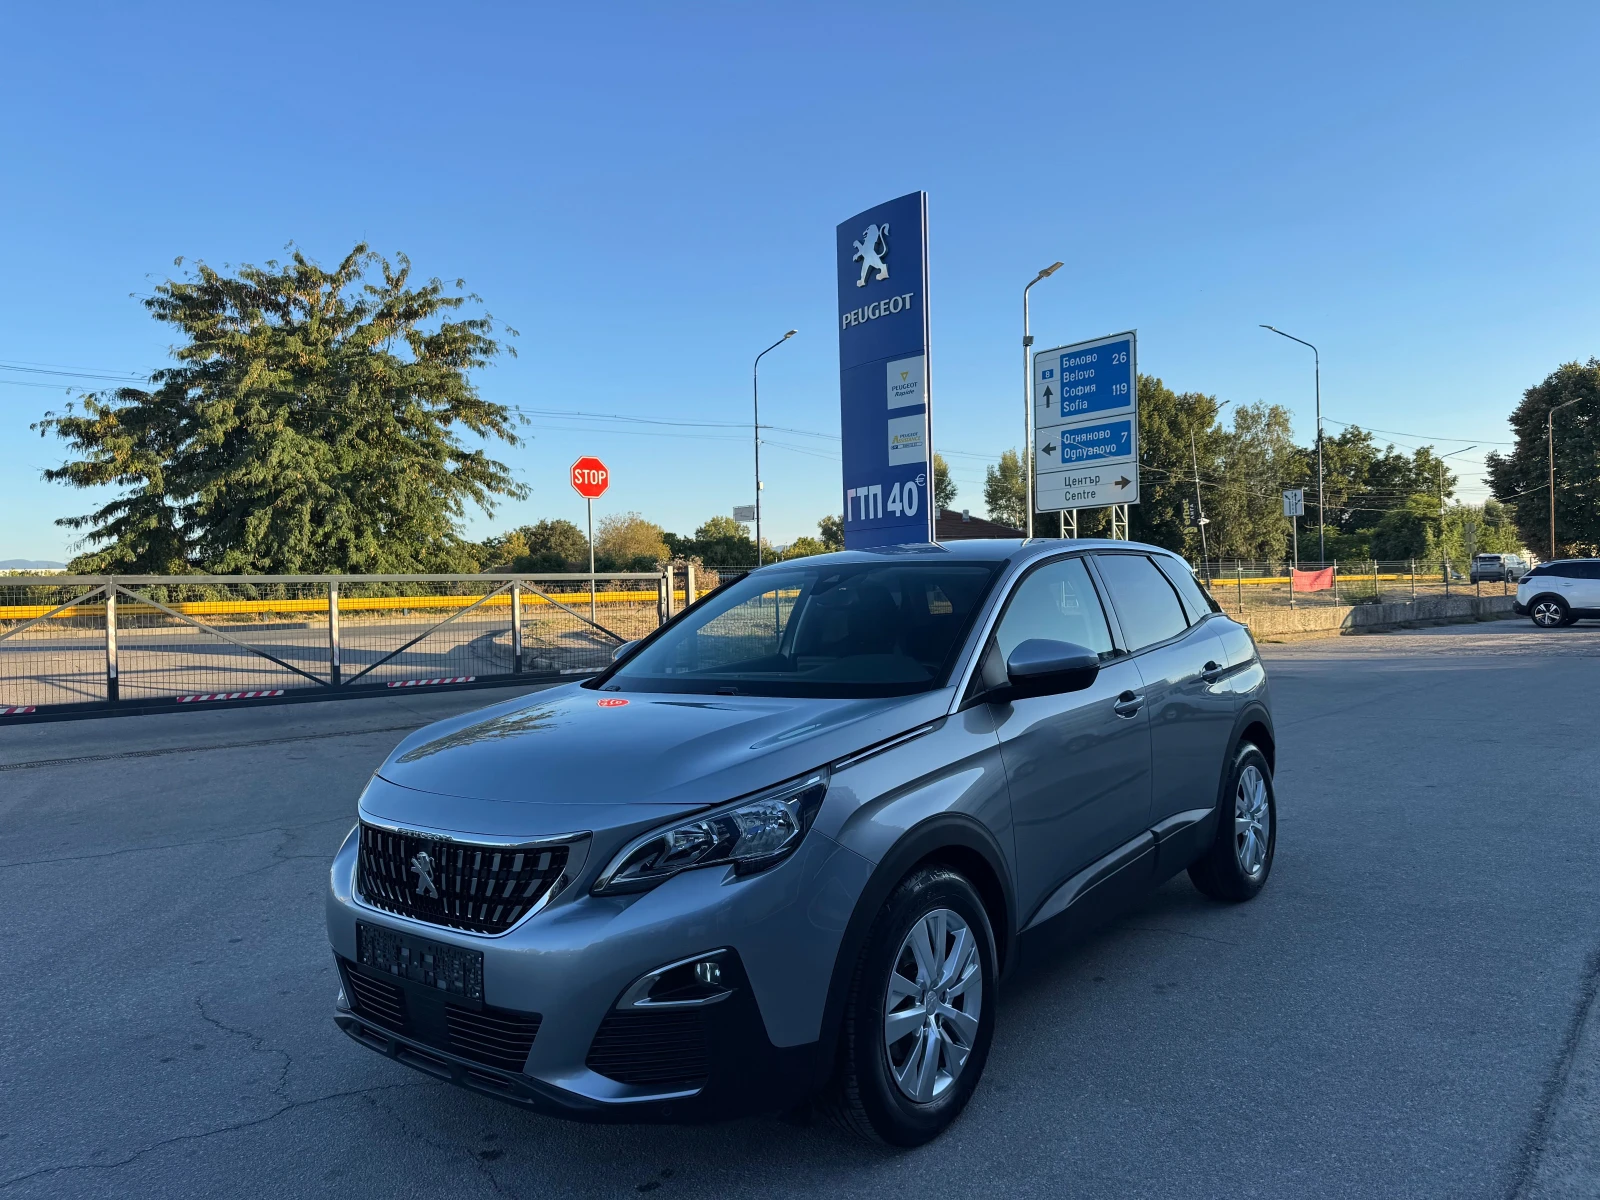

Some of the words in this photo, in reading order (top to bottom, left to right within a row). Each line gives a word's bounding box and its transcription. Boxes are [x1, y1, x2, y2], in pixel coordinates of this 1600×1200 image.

[842, 292, 914, 330] PEUGEOT
[1063, 353, 1098, 368] Белово
[1112, 351, 1127, 365] 26
[1045, 370, 1050, 378] 8
[1063, 369, 1095, 383] Belovo
[891, 381, 918, 392] PEUGEOT
[1063, 383, 1096, 398] София
[1112, 382, 1128, 396] 119
[1063, 399, 1088, 412] Sofia
[1064, 429, 1111, 444] Огняново
[1121, 431, 1128, 443] 7
[1064, 443, 1117, 461] Ognyanovo
[574, 468, 607, 485] STOP
[1064, 475, 1101, 488] Център
[1064, 489, 1096, 501] Centre
[847, 484, 883, 522] ГТП
[1182, 498, 1191, 525] efbet
